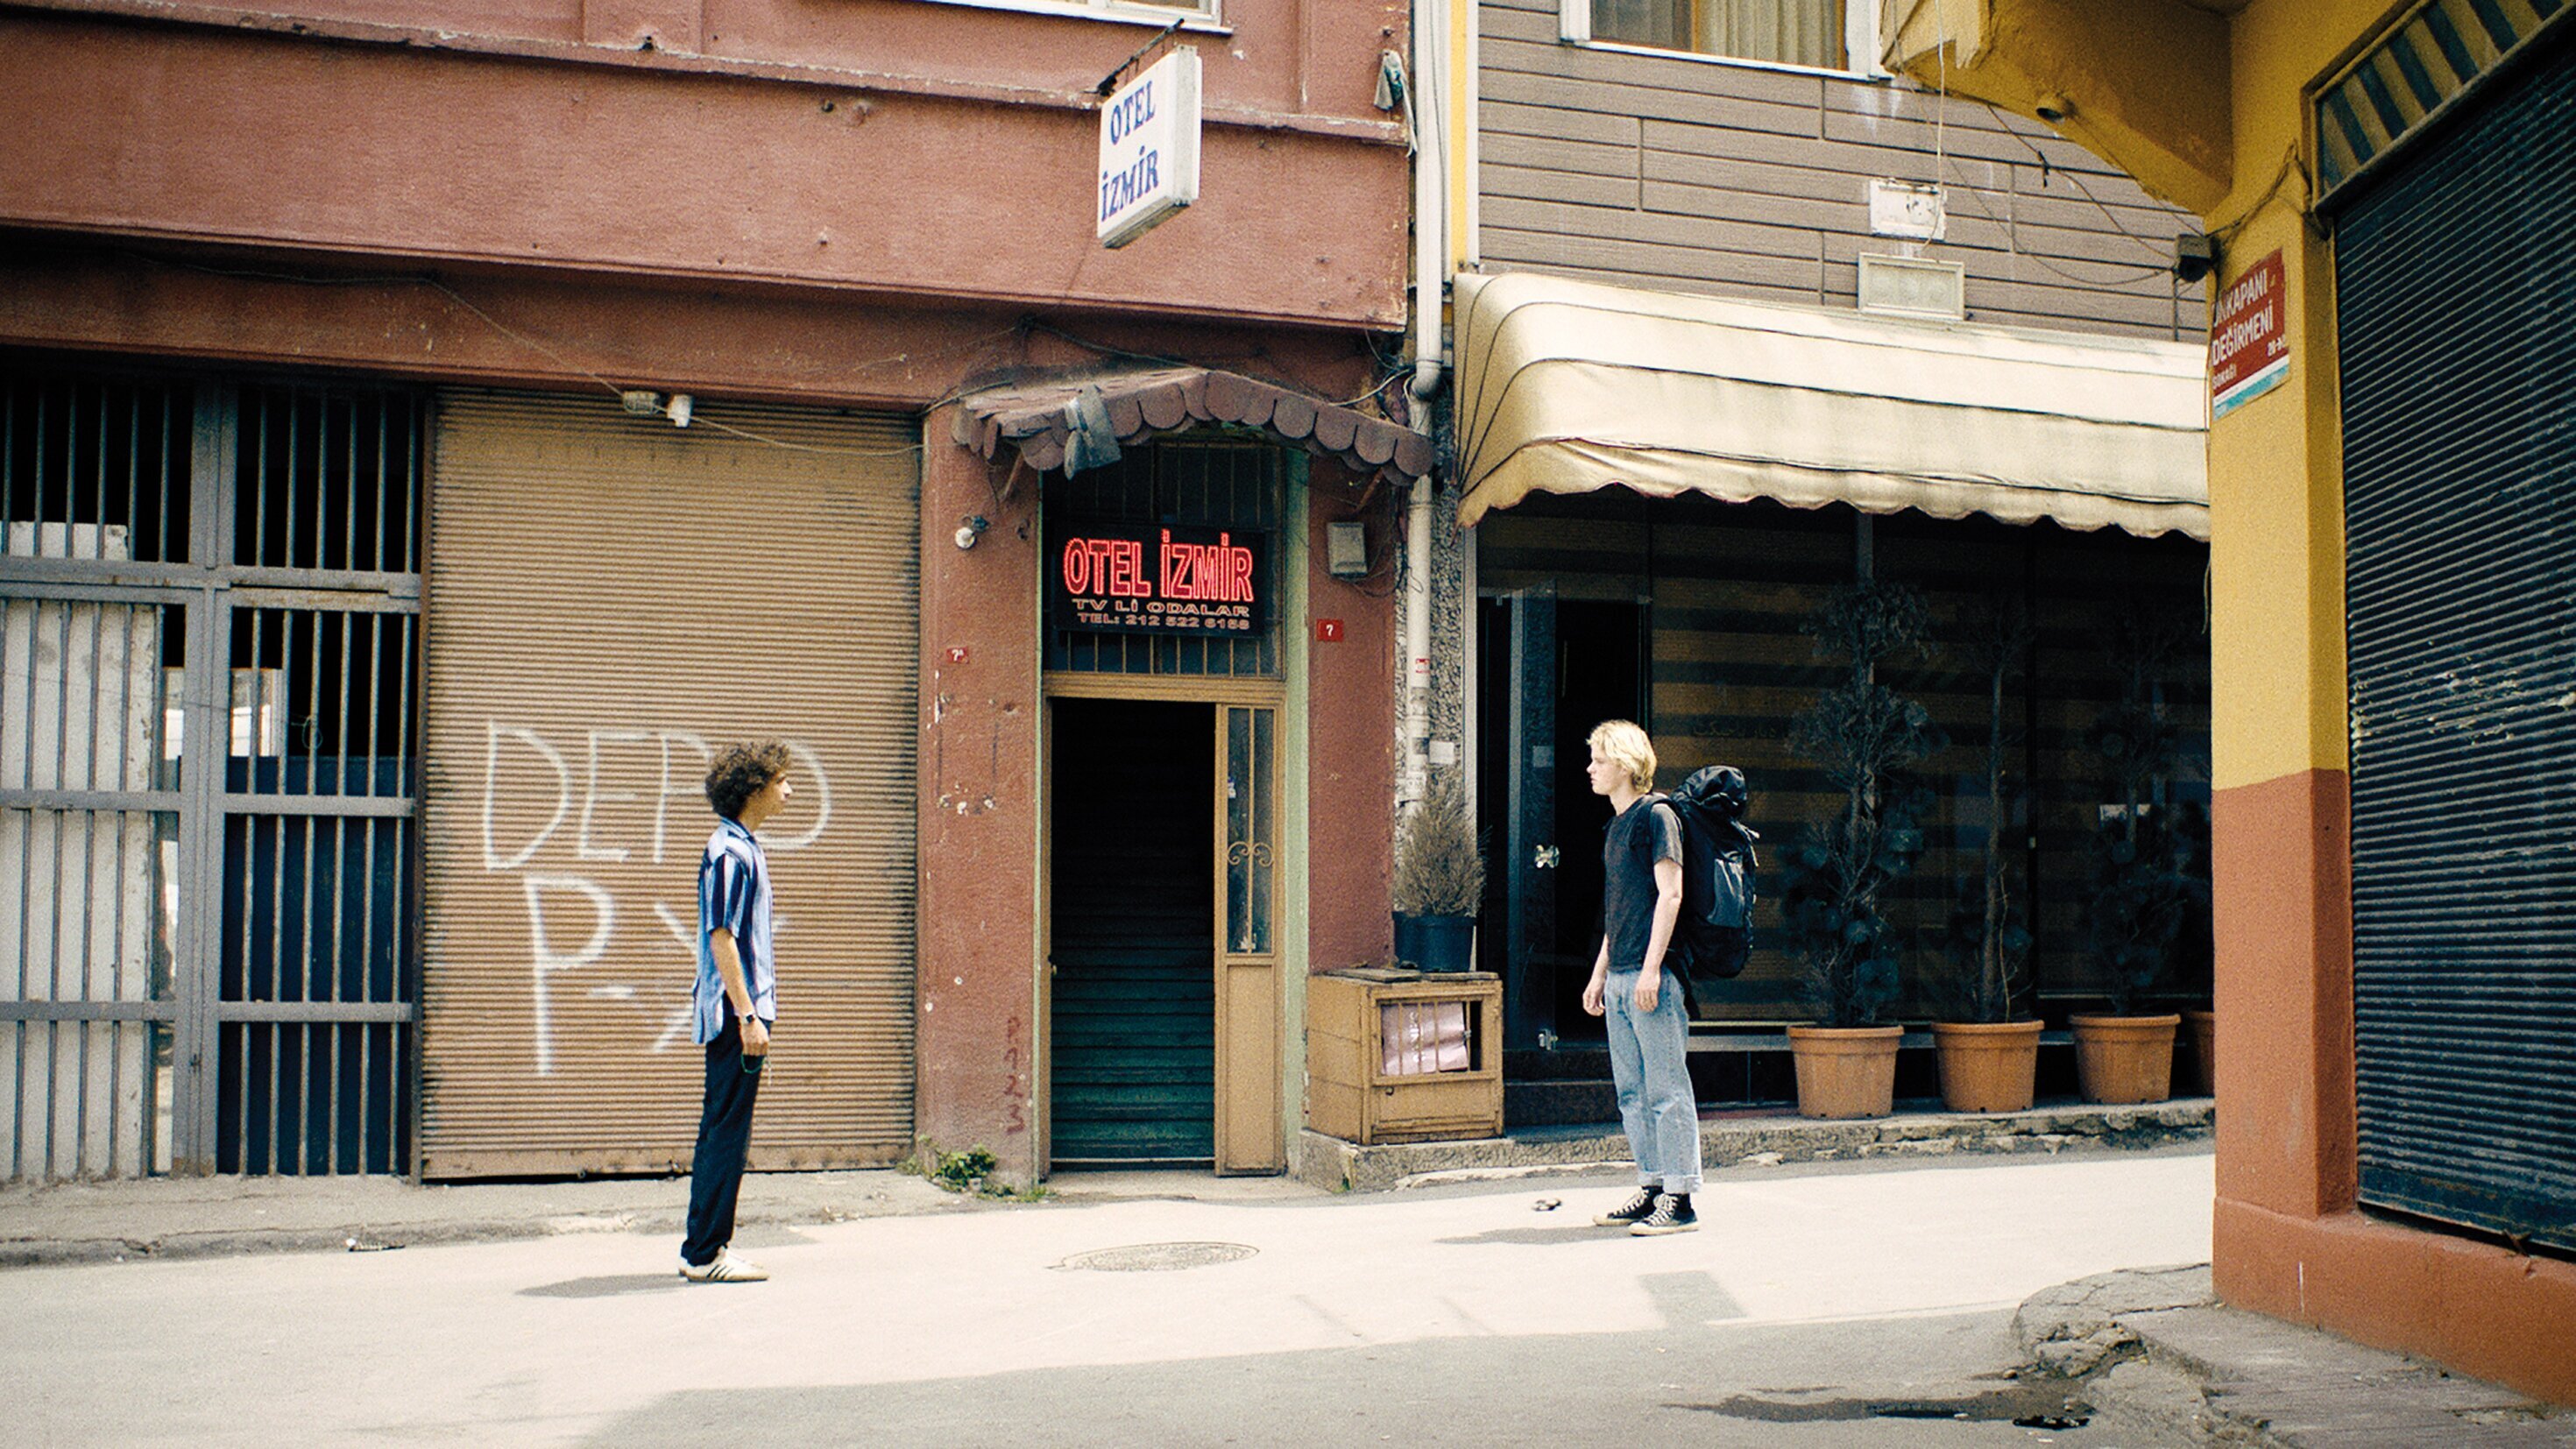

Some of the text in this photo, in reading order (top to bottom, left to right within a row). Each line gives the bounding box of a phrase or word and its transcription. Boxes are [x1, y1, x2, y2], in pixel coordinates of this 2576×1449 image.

[1109, 80, 1157, 146] OTEL
[1100, 145, 1159, 223] İZMİR
[2212, 300, 2273, 366] DEĞİRMENİ
[1063, 528, 1254, 602] OTEL İZMİR
[1071, 597, 1108, 611] TV
[1146, 602, 1249, 617] ODALAR
[1077, 612, 1120, 625] TEL:
[1124, 614, 1161, 627] 212
[1164, 616, 1200, 629] 522
